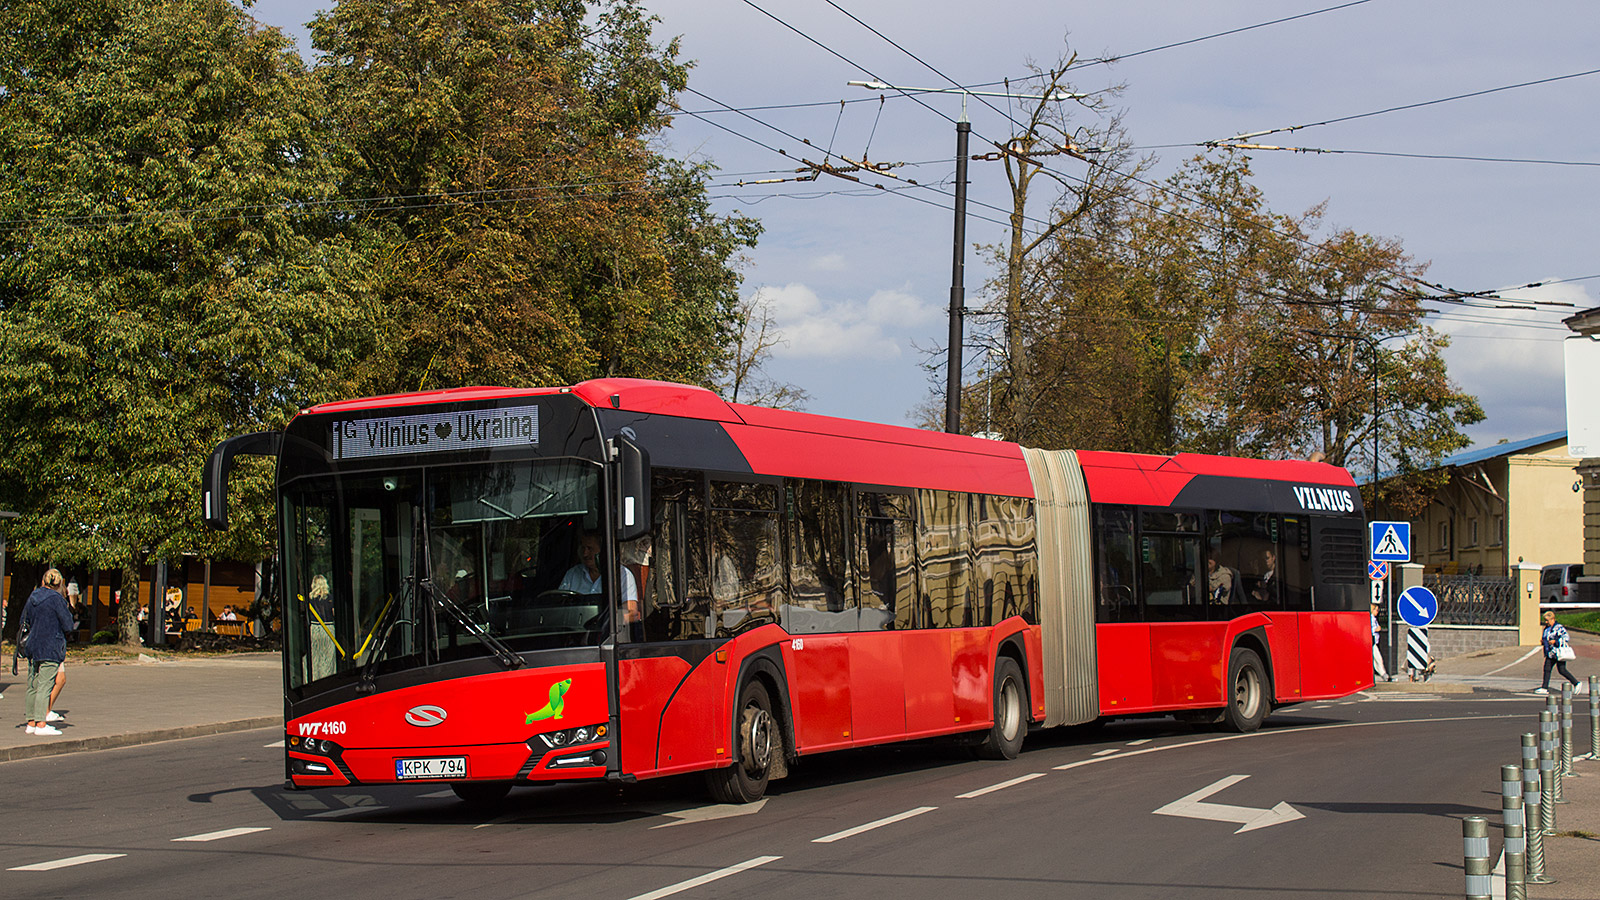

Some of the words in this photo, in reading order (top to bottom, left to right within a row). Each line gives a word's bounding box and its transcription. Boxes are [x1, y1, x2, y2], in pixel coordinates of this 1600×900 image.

[366, 420, 429, 448] Vilnius
[1292, 486, 1355, 513] VILNIUS
[322, 721, 346, 735] 4160
[404, 761, 431, 774] KPK
[440, 760, 463, 773] 794
